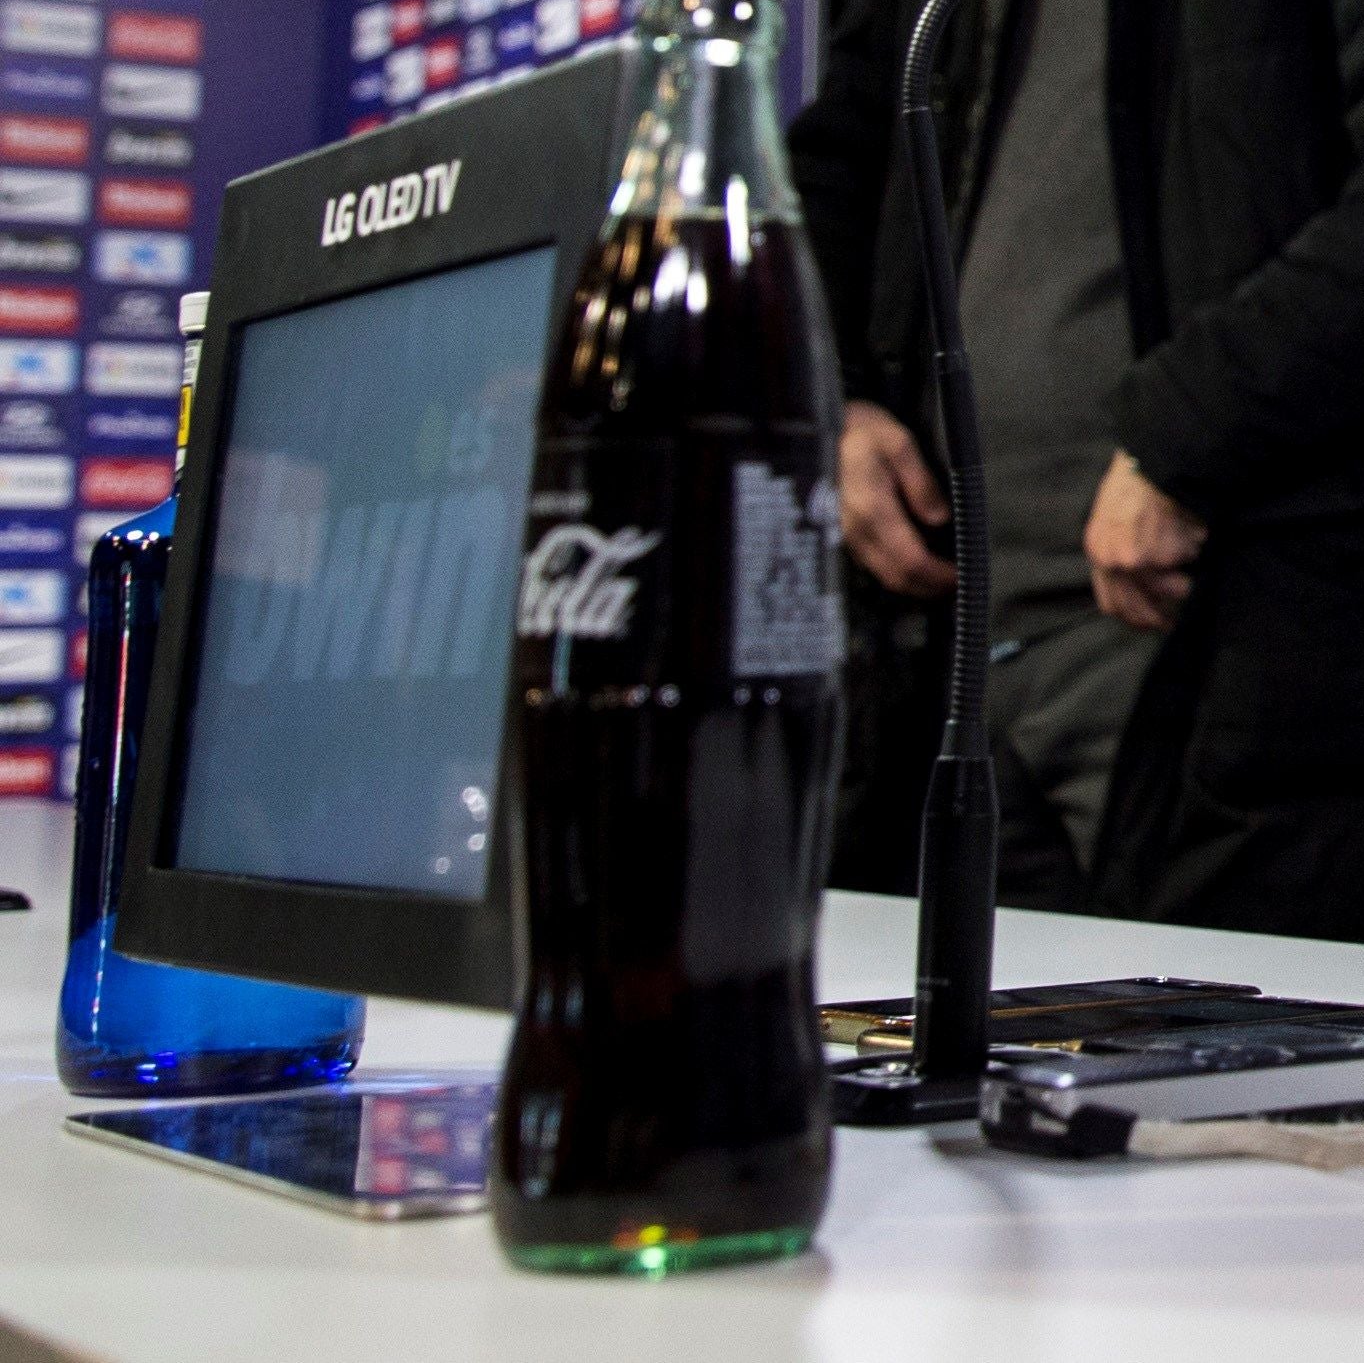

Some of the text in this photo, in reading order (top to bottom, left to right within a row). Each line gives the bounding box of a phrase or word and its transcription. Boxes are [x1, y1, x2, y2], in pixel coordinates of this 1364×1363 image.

[321, 159, 462, 246] LG OLED TV
